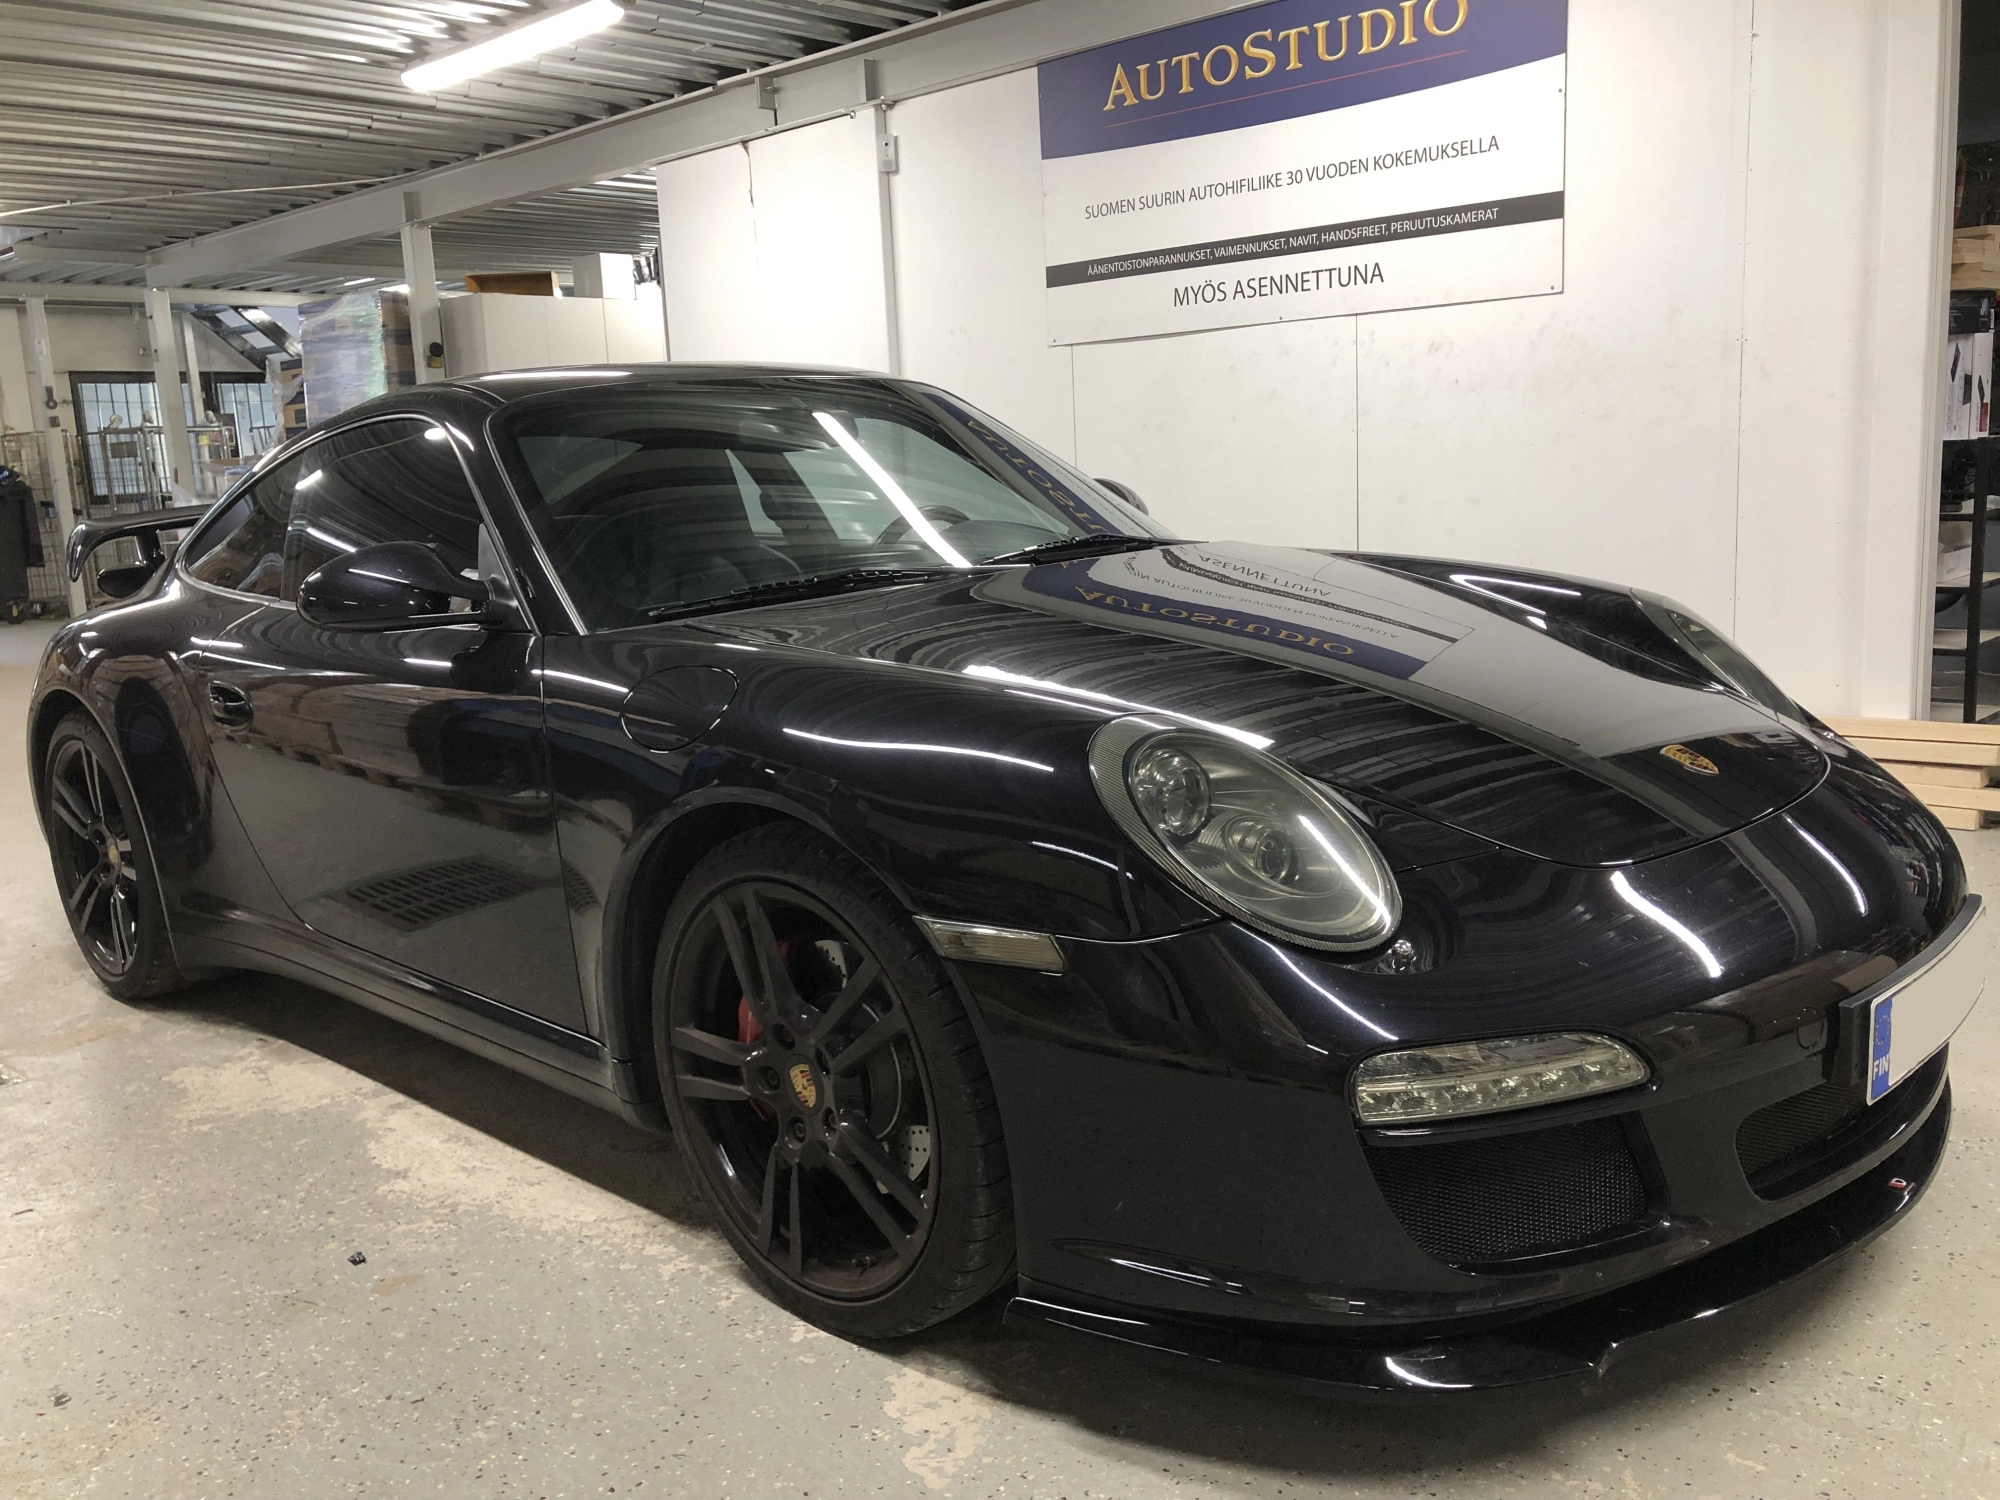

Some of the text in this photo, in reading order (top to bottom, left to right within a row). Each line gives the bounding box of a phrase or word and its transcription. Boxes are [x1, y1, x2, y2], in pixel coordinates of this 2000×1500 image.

[1085, 135, 1500, 219] SUOMEN SUURIN AUTOHIFILIIKE 30 VUODEN KOKEMUKSELLA
[1214, 237, 1288, 257] VAIMENNUKSET,
[1289, 233, 1320, 248] NAVIT,
[1321, 223, 1389, 243] HANDSFREET,
[1391, 207, 1499, 234] PERUUTUSKAMERAT
[1173, 262, 1385, 307] MYÖS ASENNETTUNA
[1873, 1053, 1889, 1081] FIN
